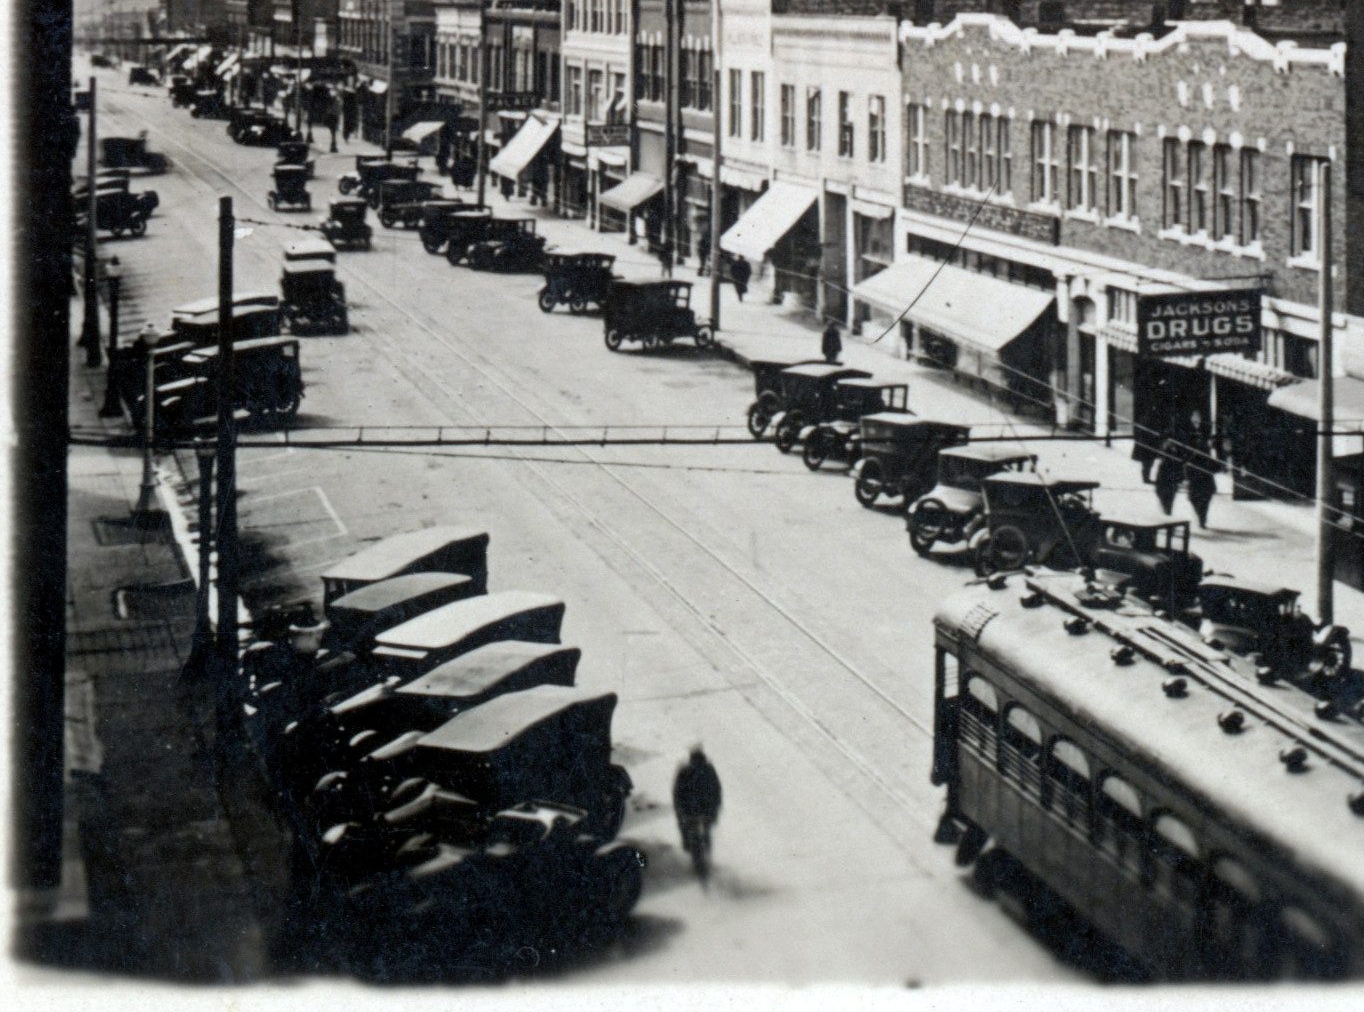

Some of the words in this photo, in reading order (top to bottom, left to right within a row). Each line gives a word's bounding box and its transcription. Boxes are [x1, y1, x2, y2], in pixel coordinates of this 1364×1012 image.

[1151, 299, 1250, 318] JACKSONS
[1146, 315, 1254, 340] DRUGS
[1150, 339, 1197, 352] CIGARS
